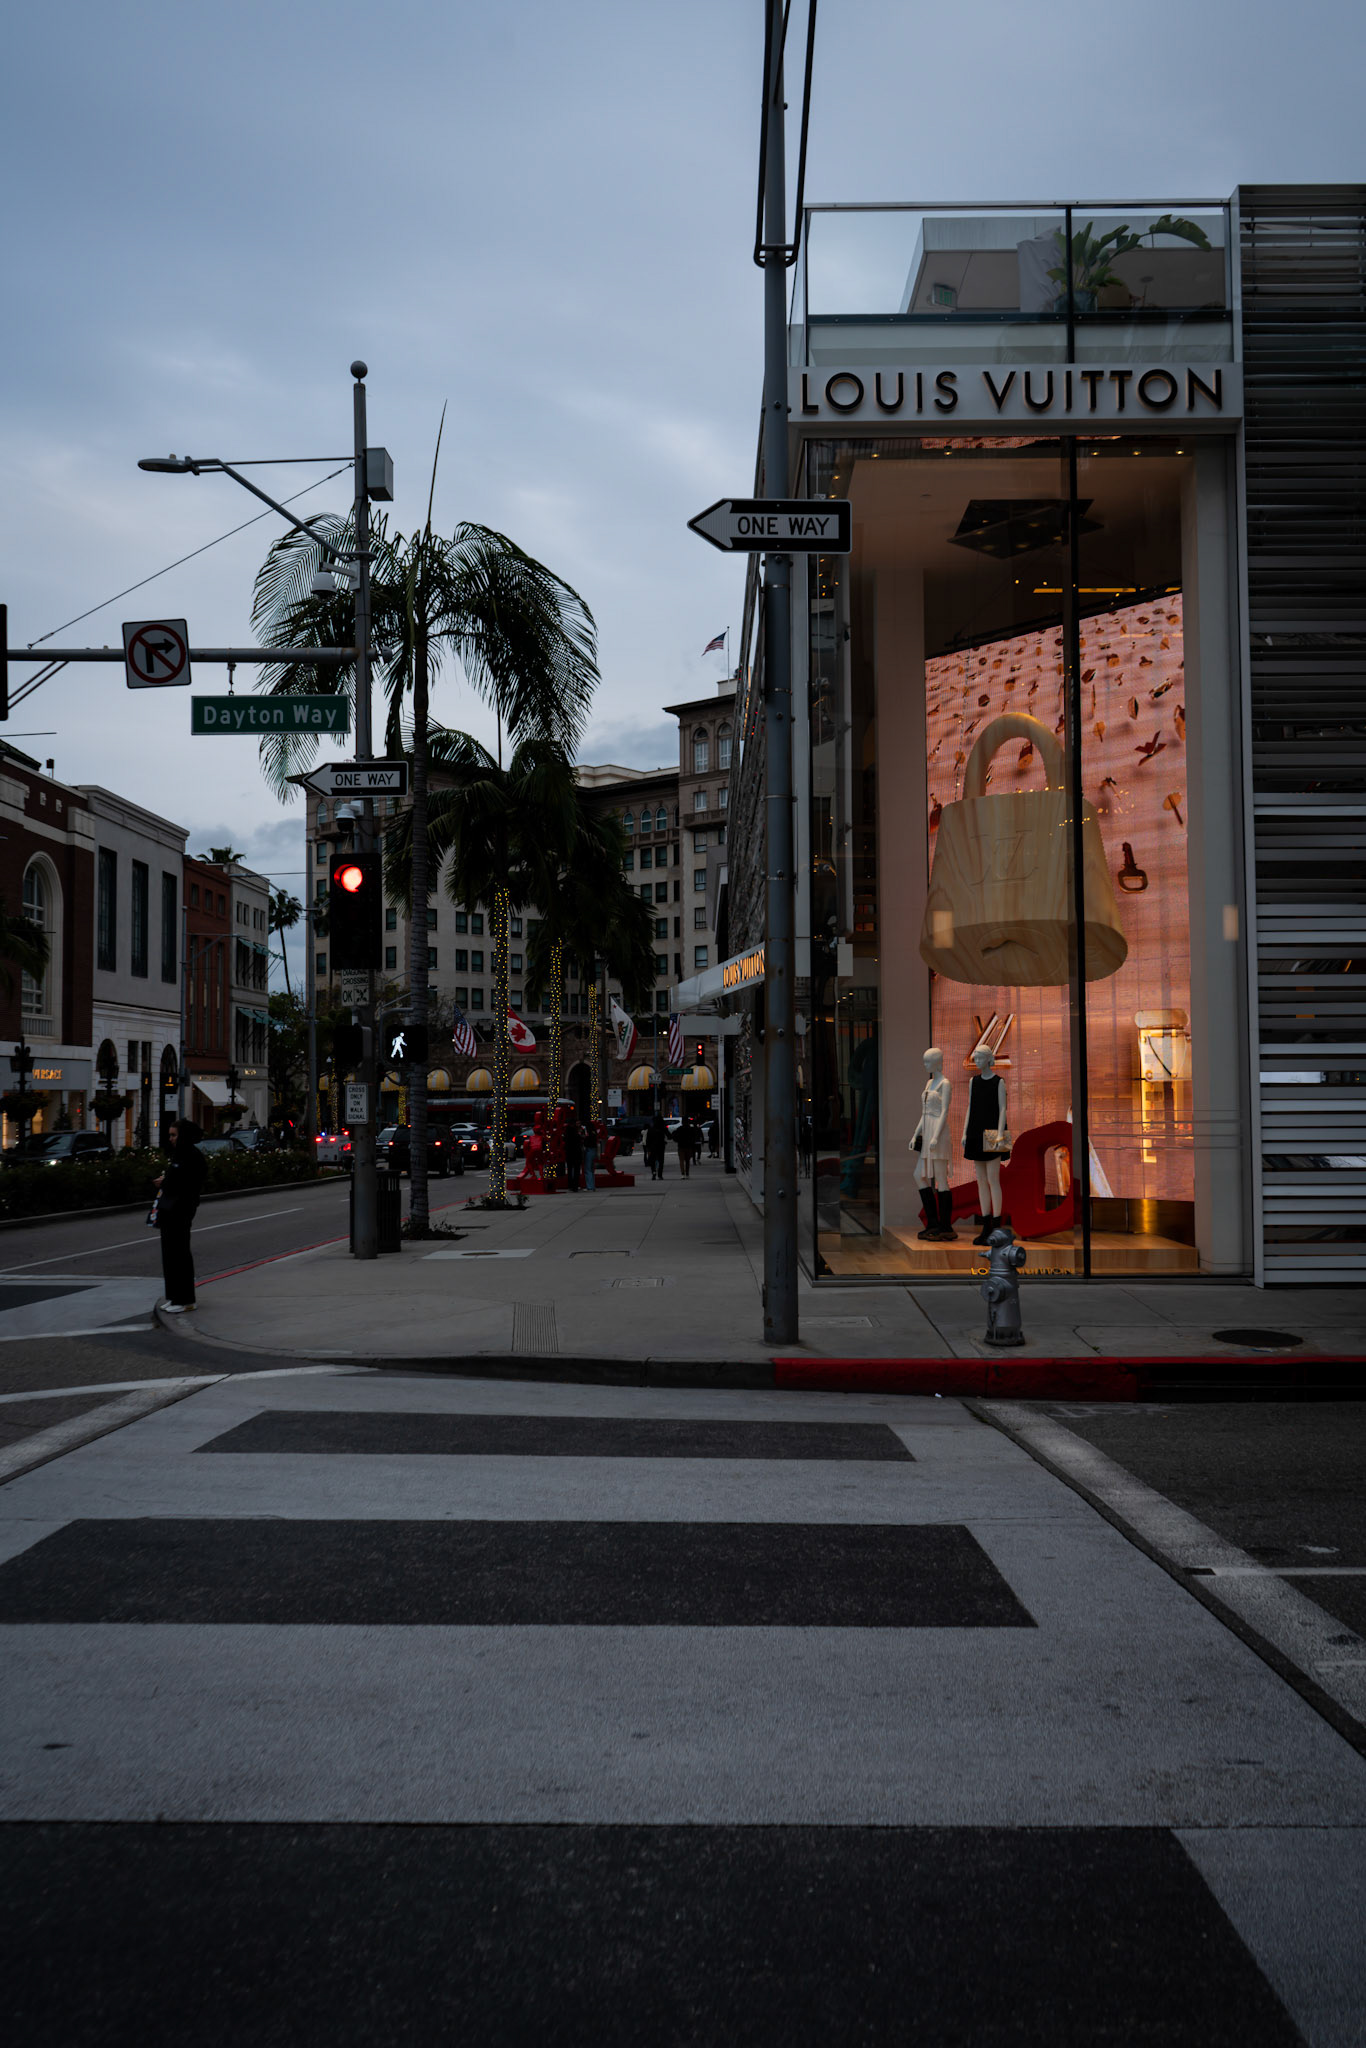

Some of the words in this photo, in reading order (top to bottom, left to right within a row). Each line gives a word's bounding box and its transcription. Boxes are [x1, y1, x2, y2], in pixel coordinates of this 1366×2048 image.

[802, 371, 958, 412] LOUIS
[983, 368, 1222, 411] VUITTON
[737, 516, 778, 535] ONE
[789, 517, 829, 535] WAY
[203, 705, 284, 729] Dayton
[293, 704, 337, 728] Way
[335, 773, 361, 786] ONE
[367, 773, 394, 785] WAY
[723, 960, 740, 989] LOUIS
[740, 949, 765, 982] VUITTON
[343, 977, 369, 985] CROSSING
[343, 990, 353, 1002] OK
[32, 1069, 62, 1080] VERSACE
